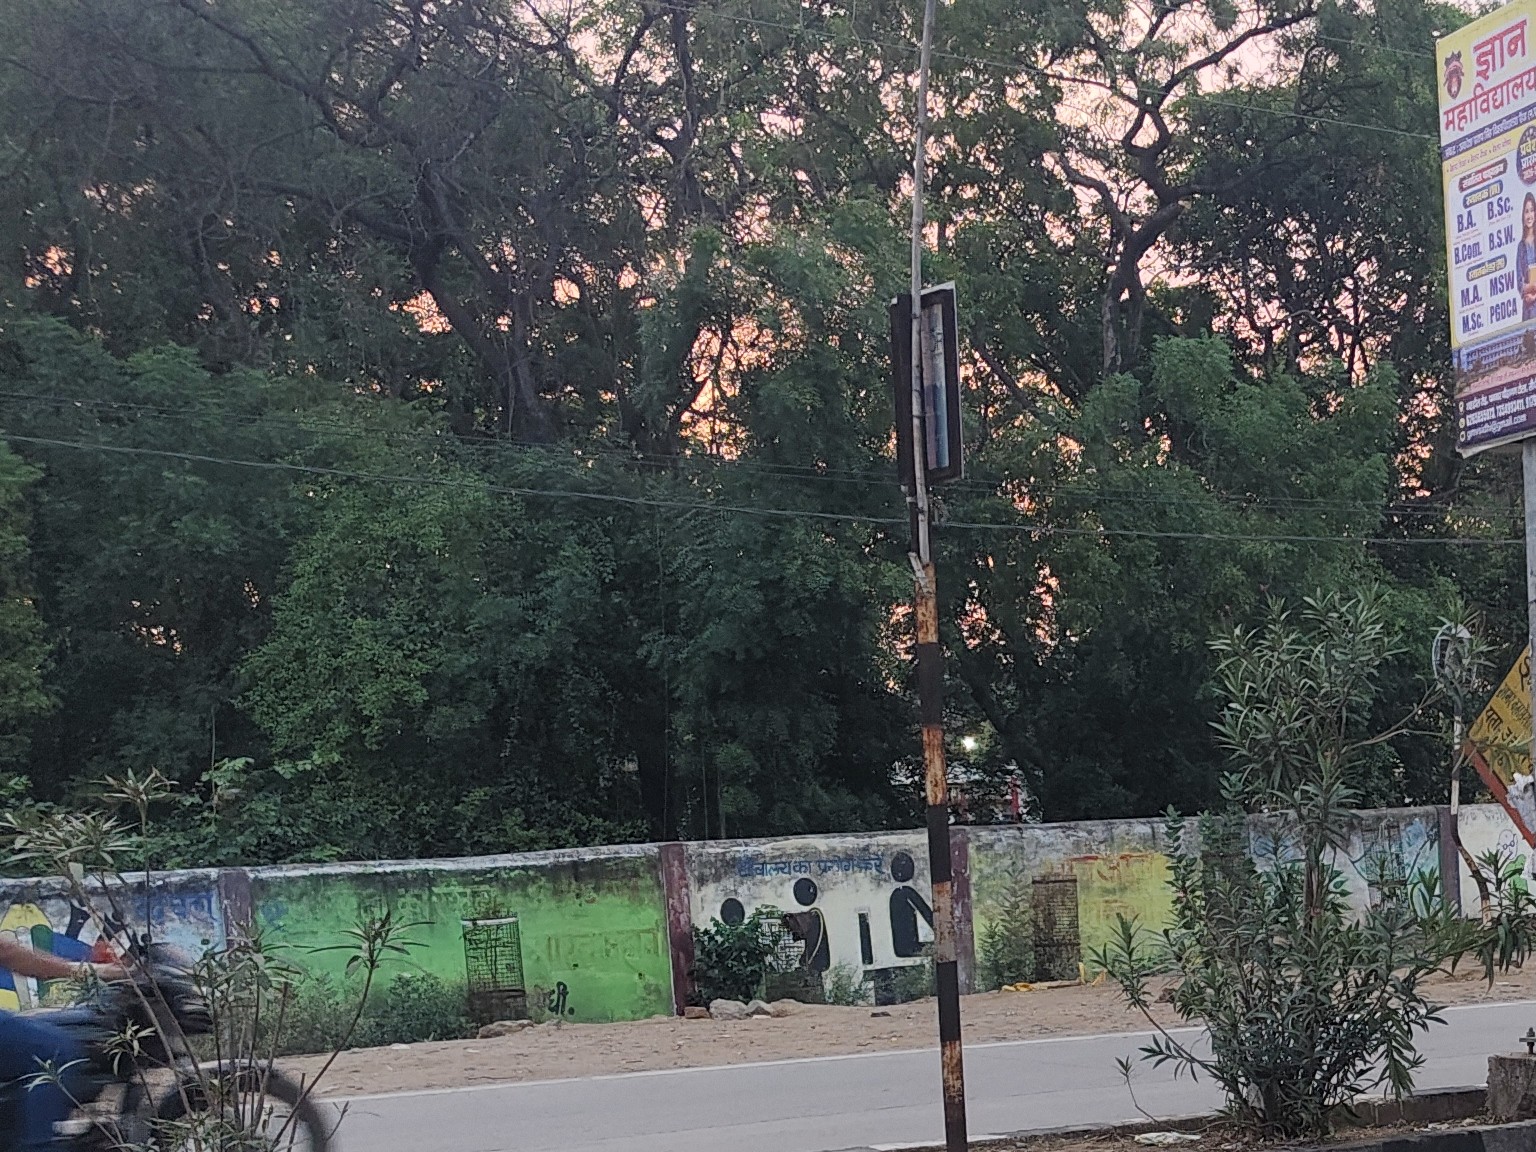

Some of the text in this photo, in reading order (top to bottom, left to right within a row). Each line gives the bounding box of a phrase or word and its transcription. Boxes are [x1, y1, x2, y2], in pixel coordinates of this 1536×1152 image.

[1473, 19, 1527, 80] ज्ञान
[1457, 209, 1476, 233] B.A.
[1487, 197, 1513, 221] B.Sc.
[1488, 224, 1515, 251] B.S.W.
[1460, 284, 1482, 308] M.A.
[1489, 270, 1515, 298] MSW
[1489, 297, 1518, 324] PGDCA
